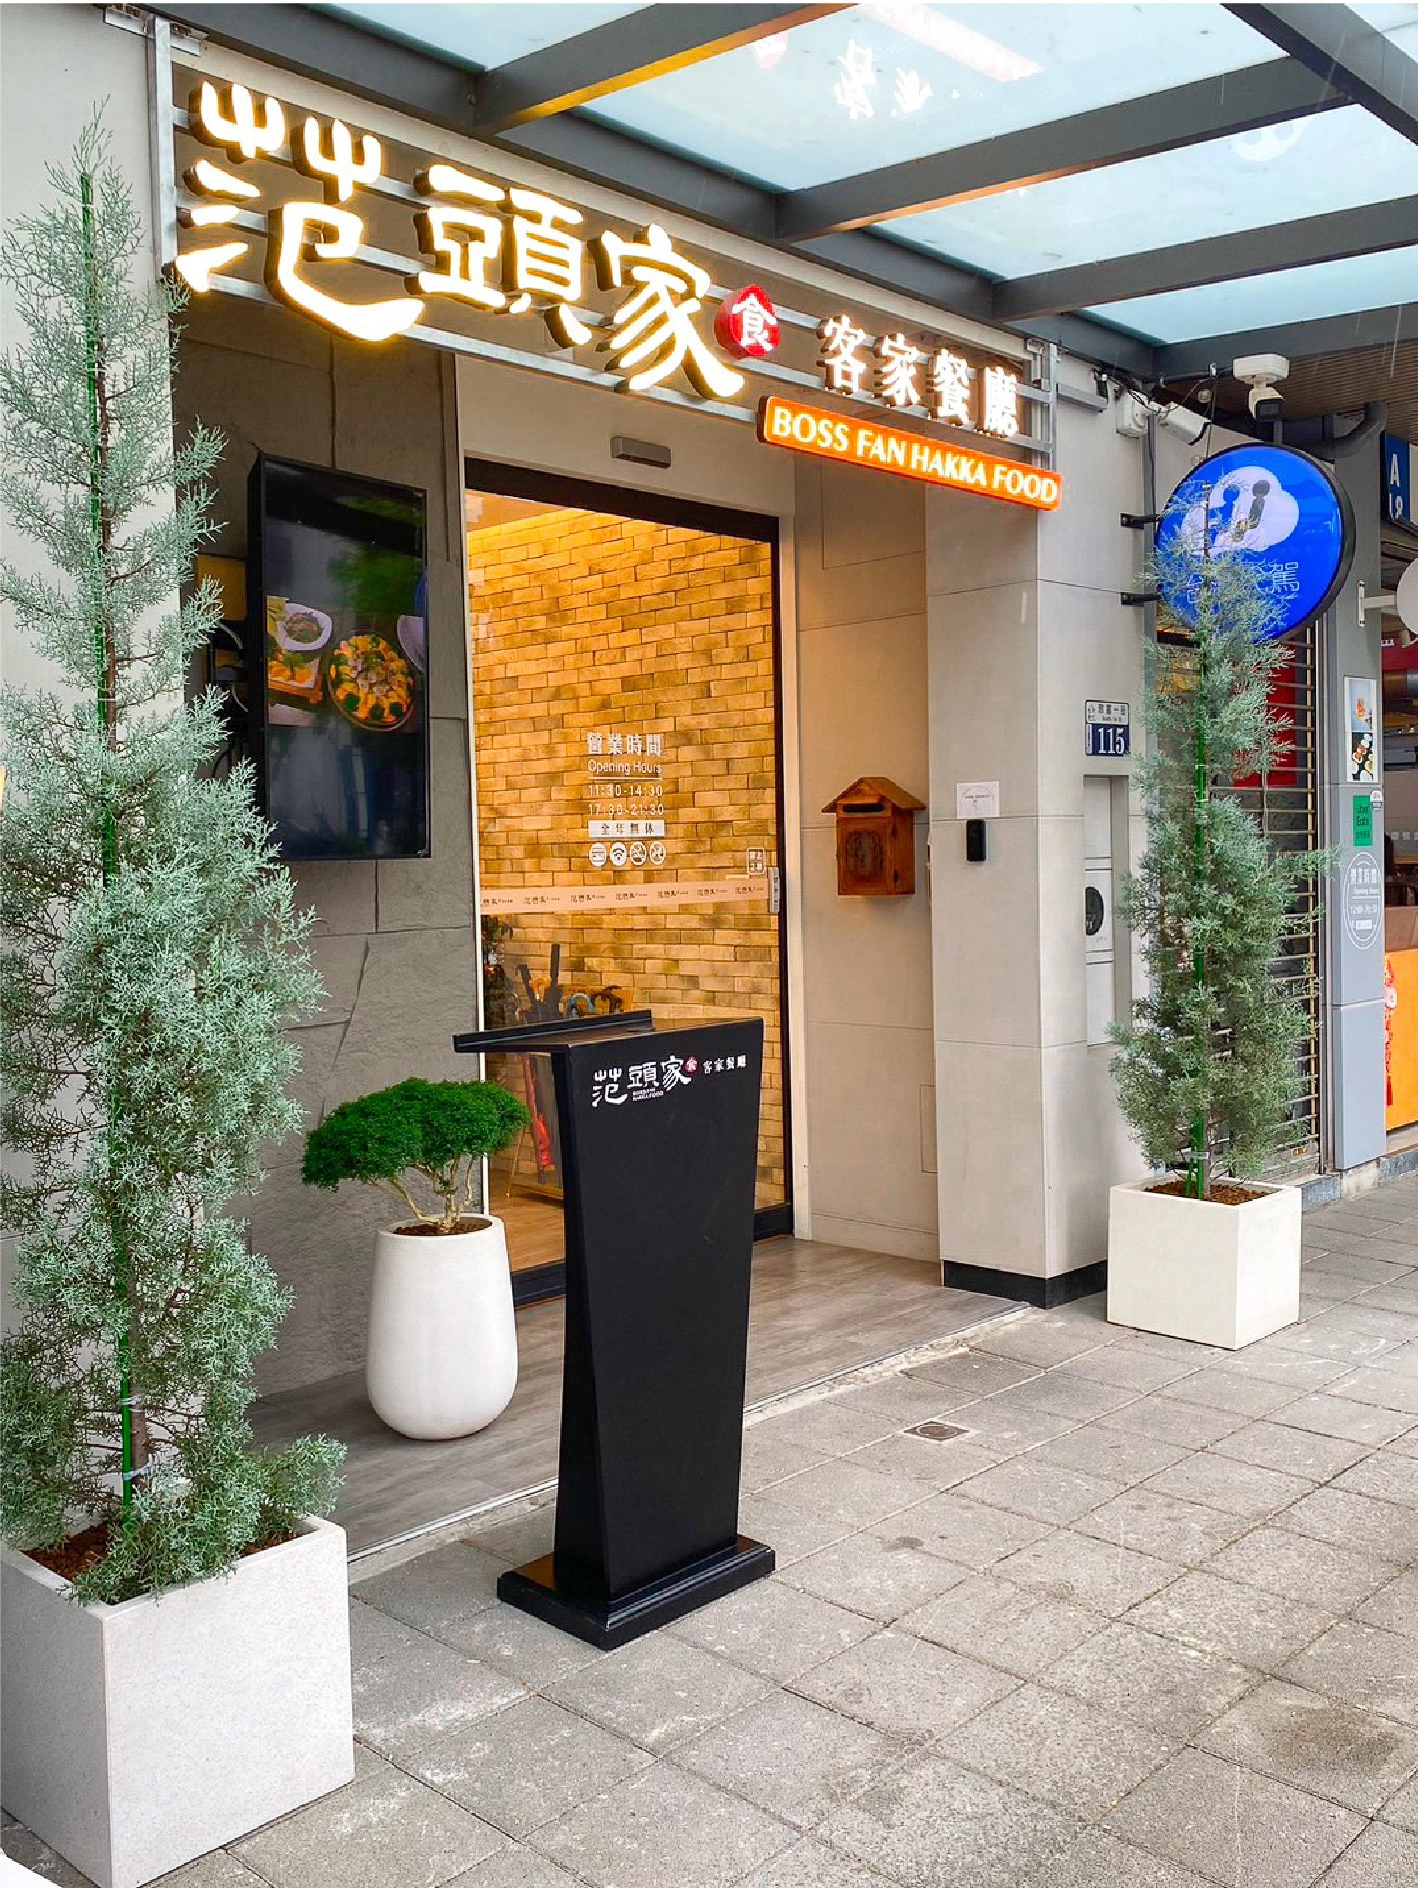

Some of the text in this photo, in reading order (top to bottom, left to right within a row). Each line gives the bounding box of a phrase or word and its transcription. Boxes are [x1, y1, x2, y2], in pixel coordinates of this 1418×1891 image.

[772, 405, 1059, 504] BOSS FAN HAKKA FOOD
[587, 731, 663, 757] 營業時間
[1097, 727, 1125, 754] 115
[587, 758, 663, 776] Opening Hours
